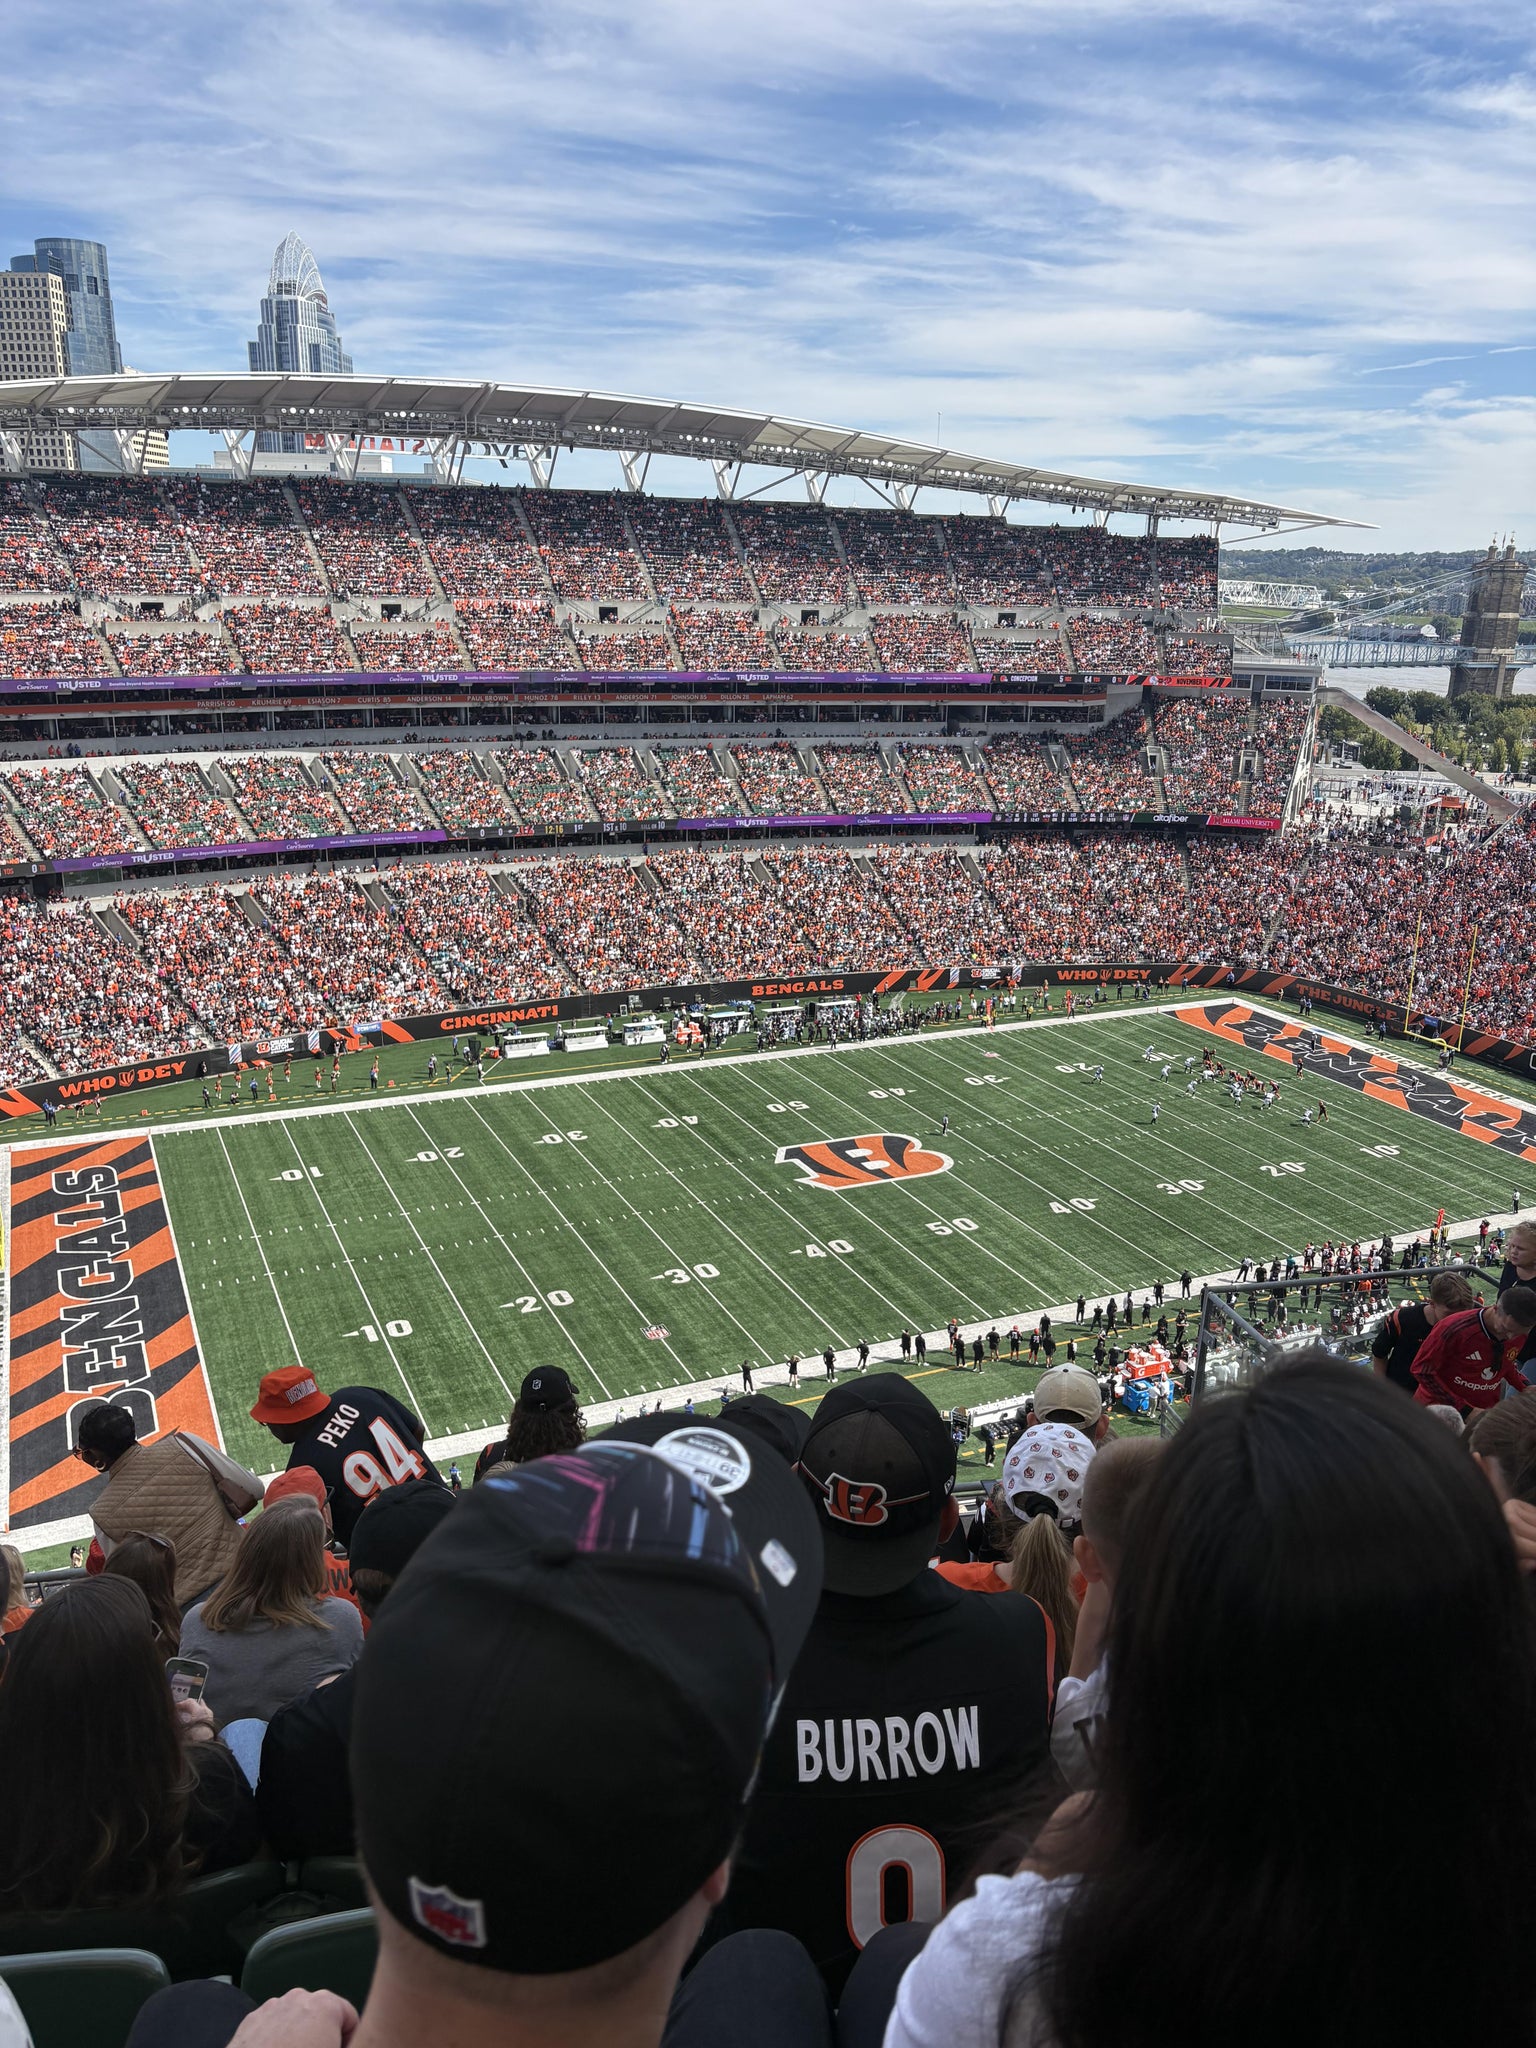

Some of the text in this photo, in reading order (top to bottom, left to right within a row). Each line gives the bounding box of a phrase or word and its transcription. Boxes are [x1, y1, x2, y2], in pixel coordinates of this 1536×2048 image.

[422, 674, 458, 682] TRUSTED
[736, 674, 769, 682] TRUSTED
[1084, 675, 1092, 683] 64
[1176, 678, 1203, 686] NOVEMBER
[57, 681, 101, 690] TRUSTED
[735, 819, 768, 827] TRUSTED
[1153, 813, 1188, 823] altafiber
[1242, 819, 1274, 827] UNIVERSITY
[545, 825, 564, 835] 12:16
[574, 824, 583, 833] 1ST
[603, 822, 614, 832] 1ST
[619, 822, 627, 831] 10
[658, 820, 665, 830] 10
[479, 829, 485, 837] 0
[498, 828, 503, 836] 0
[131, 853, 175, 864] TRUSTED
[31, 864, 38, 873] 0
[1058, 969, 1150, 980] WHO DEY
[752, 979, 844, 997] BENGALS
[1296, 983, 1397, 1020] THE JUNGLE
[440, 1004, 559, 1031] CINCINNATI
[270, 1037, 294, 1048] CRUCIAL
[1054, 1061, 1094, 1073] 20
[58, 1061, 187, 1098] WHO DEY
[963, 1073, 1004, 1086] 30
[1365, 1047, 1518, 1101] CRUCIAL CATCH
[1222, 1020, 1536, 1152] BENGAL
[867, 1087, 906, 1099] 40
[766, 1100, 810, 1113] 50
[656, 1114, 699, 1128] 40
[541, 1130, 588, 1146] 30
[416, 1146, 465, 1163] 20
[1360, 1145, 1400, 1158] 10
[280, 1165, 325, 1182] 10
[1259, 1161, 1304, 1177] 20
[1156, 1178, 1204, 1195] 30
[1049, 1197, 1096, 1214] 40
[925, 1217, 980, 1236] 50
[804, 1238, 855, 1259] 40
[663, 1263, 720, 1284] 30
[52, 1164, 160, 1451] BENGALS
[514, 1289, 575, 1314] 20
[359, 1319, 414, 1343] 10
[1453, 1376, 1504, 1391] Snapdrag
[317, 1403, 360, 1449] PEKO
[343, 1416, 424, 1508] 94
[796, 1705, 981, 1783] BURROW
